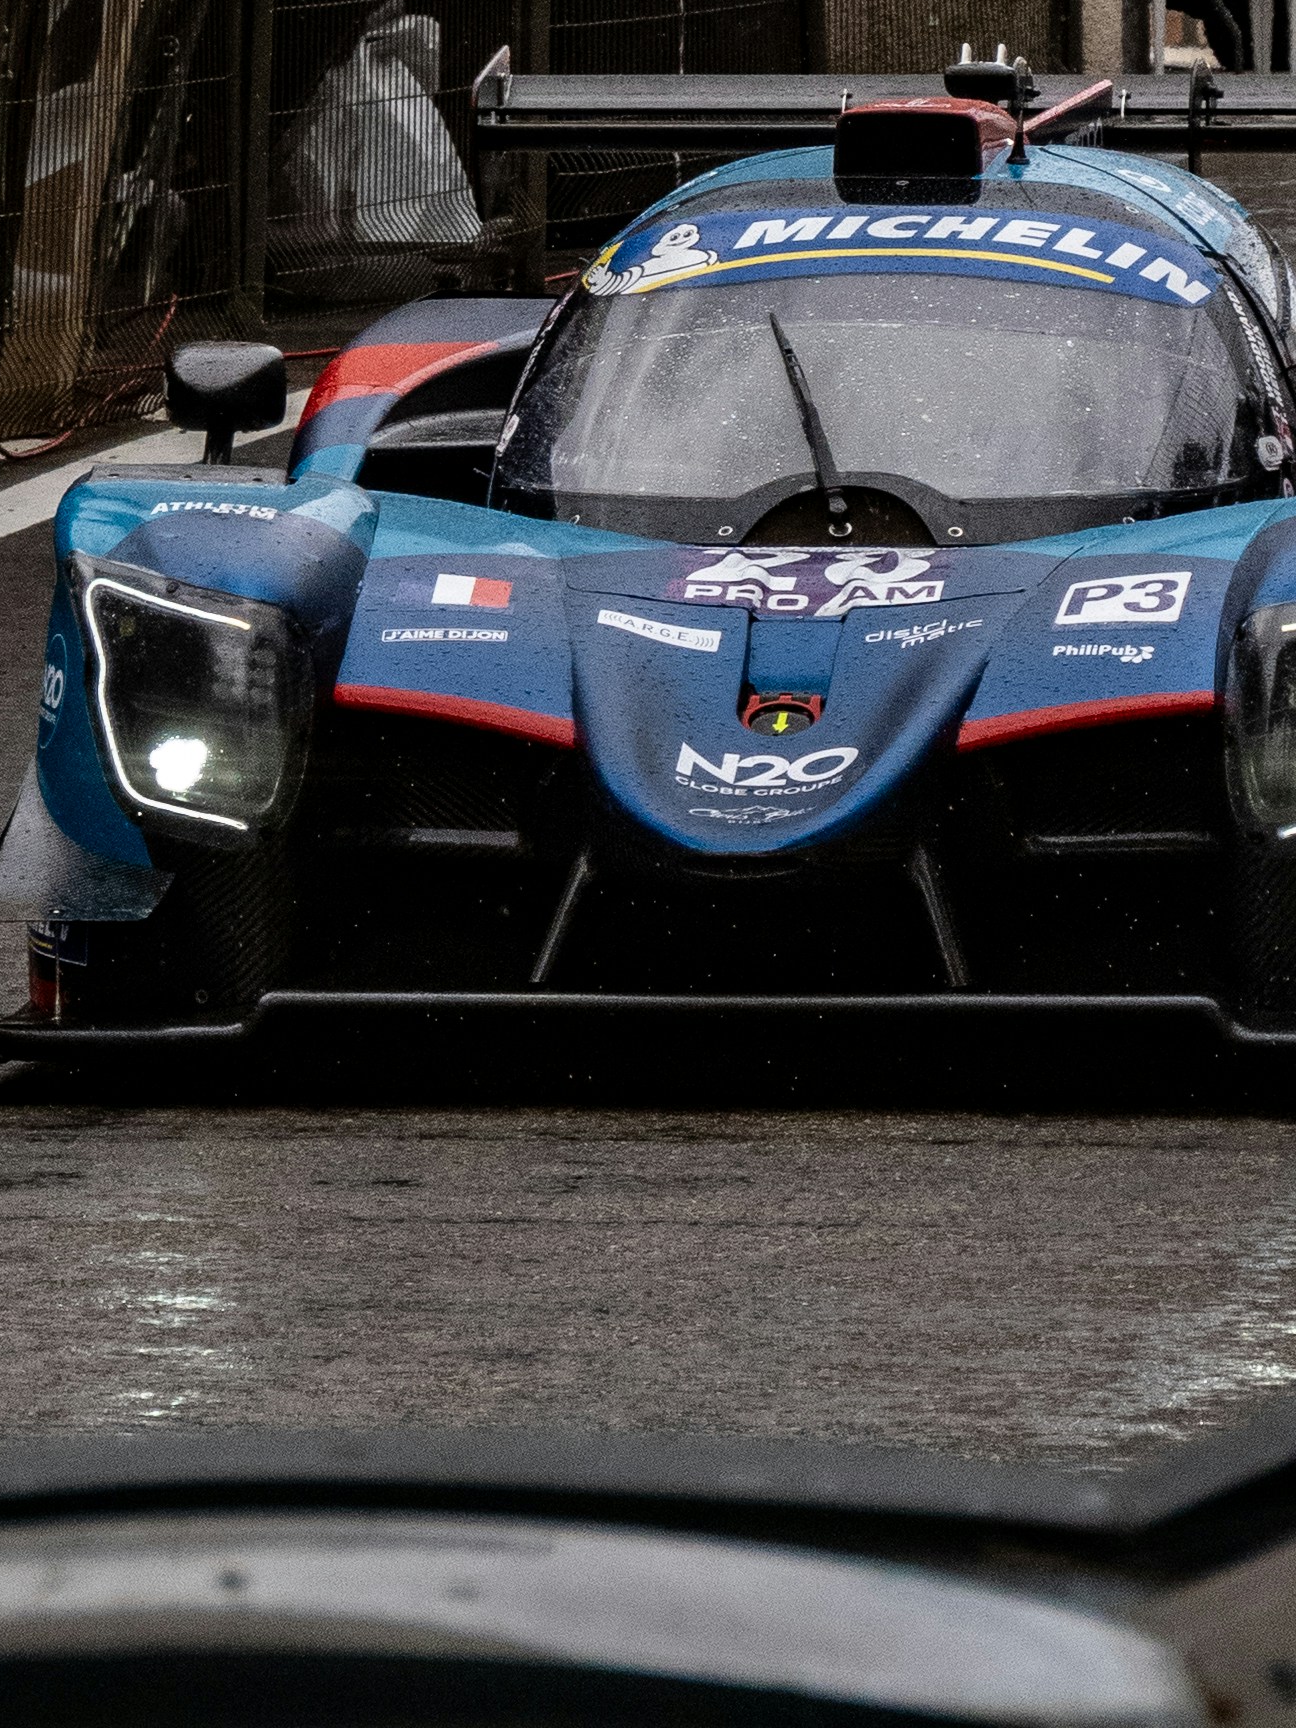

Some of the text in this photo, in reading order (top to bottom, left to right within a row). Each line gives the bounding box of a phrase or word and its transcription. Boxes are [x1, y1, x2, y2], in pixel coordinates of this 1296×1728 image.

[731, 215, 1212, 305] MICHELIN
[684, 583, 937, 611] PRO AM
[1062, 579, 1181, 617] P3
[385, 629, 506, 641] J'AIME DIJON
[675, 774, 845, 796] GLOBE GROUPE
